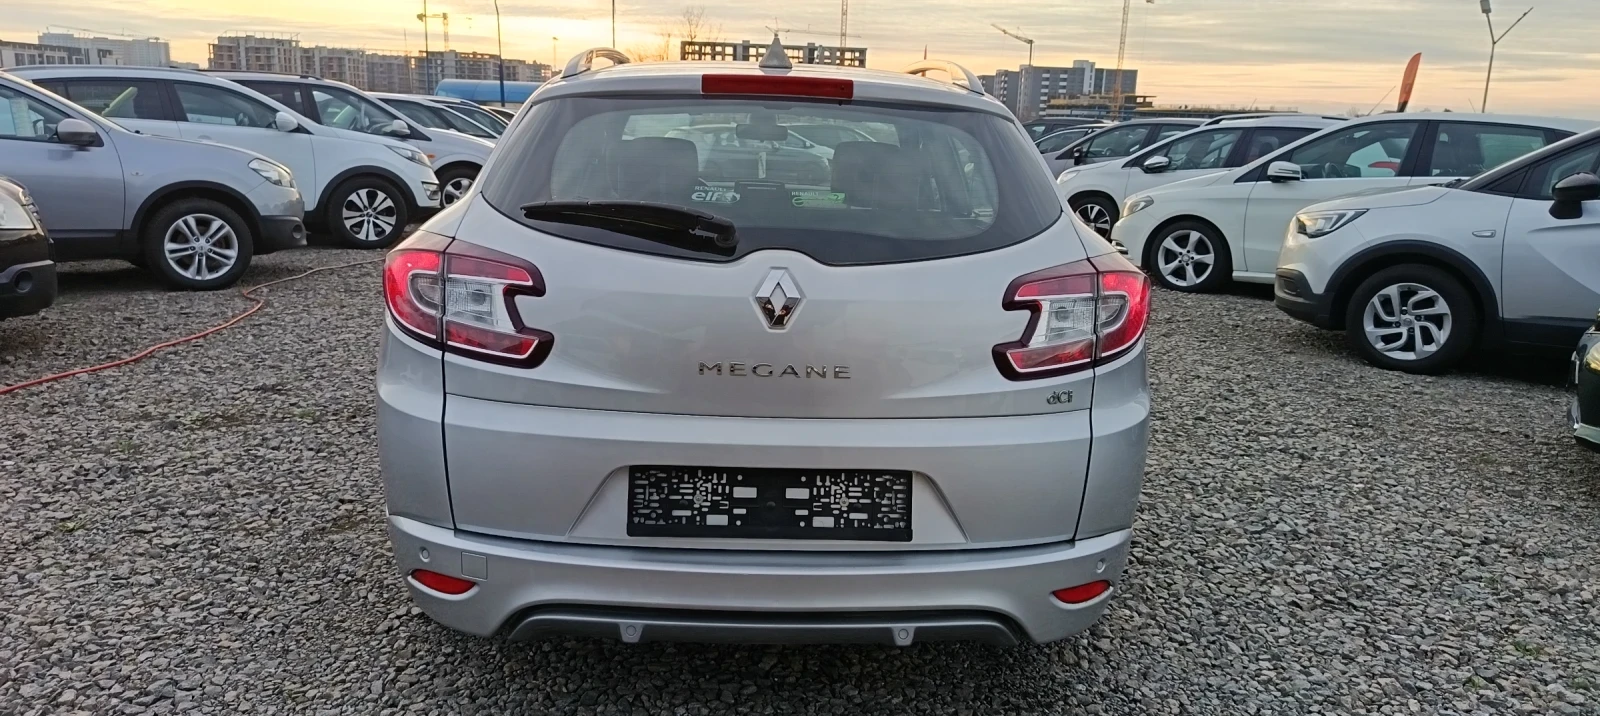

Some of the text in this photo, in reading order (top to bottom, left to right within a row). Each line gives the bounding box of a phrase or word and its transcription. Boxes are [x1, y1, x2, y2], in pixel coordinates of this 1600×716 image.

[691, 191, 724, 201] elf
[698, 361, 851, 379] MEGANE
[1046, 390, 1073, 404] dCi
